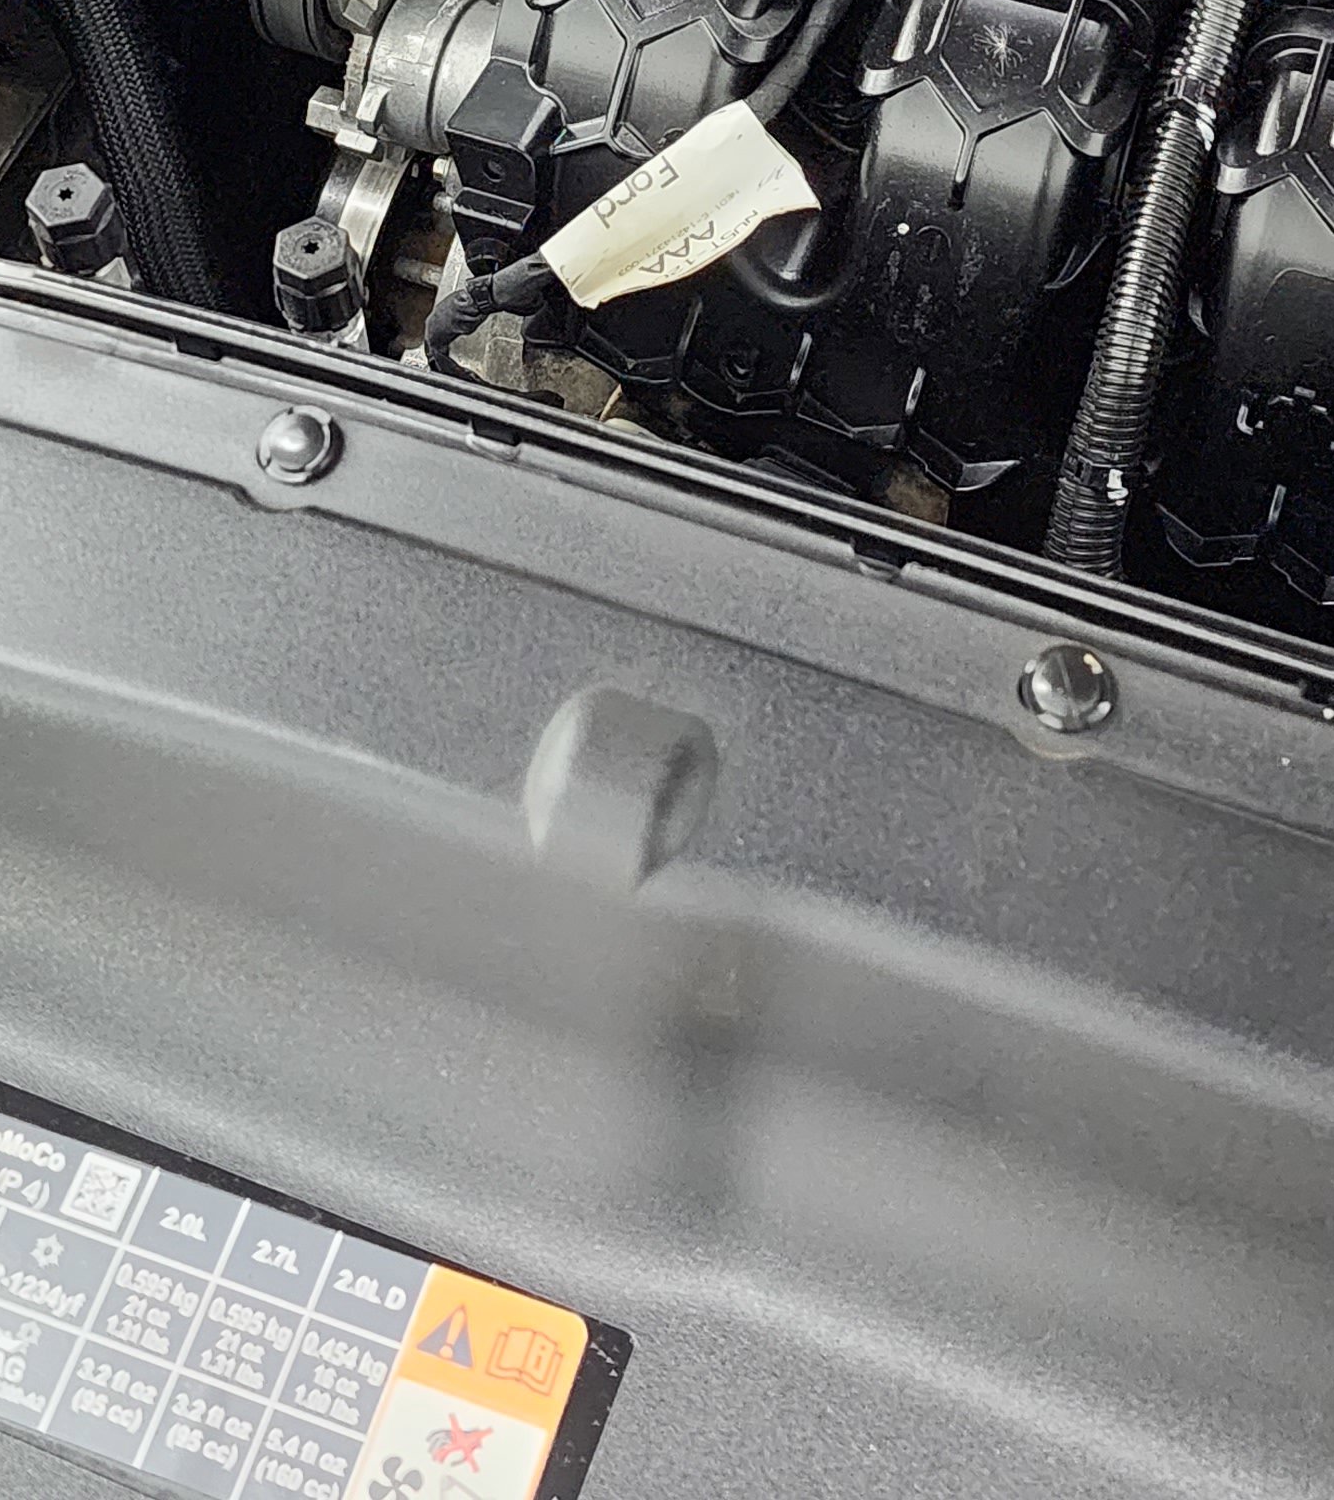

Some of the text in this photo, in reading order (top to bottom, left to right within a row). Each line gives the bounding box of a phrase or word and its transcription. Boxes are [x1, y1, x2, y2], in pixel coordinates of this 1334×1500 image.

[585, 154, 680, 230] Ford
[637, 219, 715, 274] AAA
[21, 1180, 48, 1211] 4)
[160, 1207, 205, 1240] 2.0L
[252, 1240, 298, 1273] 2.7L
[333, 1269, 405, 1309] 2.0L D
